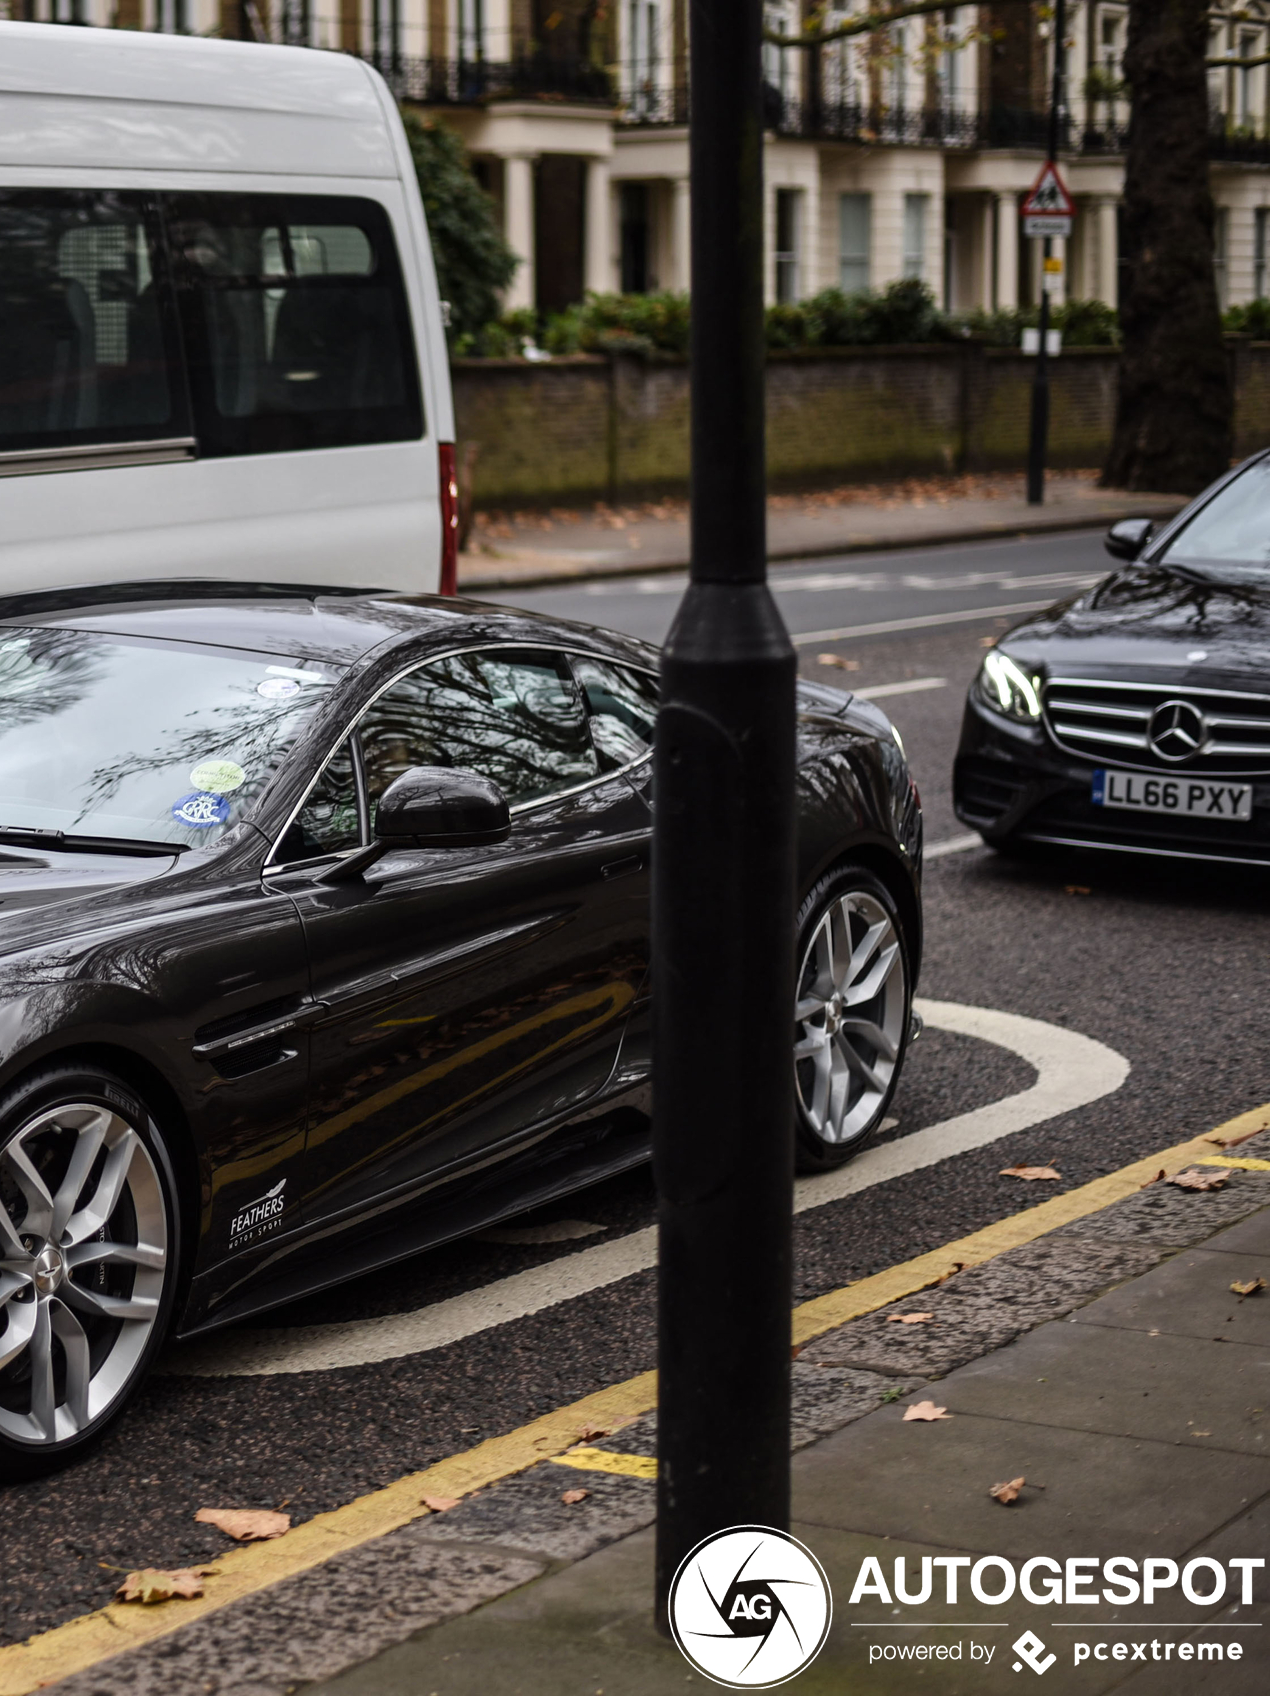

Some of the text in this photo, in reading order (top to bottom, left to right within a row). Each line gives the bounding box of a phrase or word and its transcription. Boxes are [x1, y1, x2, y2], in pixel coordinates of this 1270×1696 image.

[1107, 775, 1246, 816] LL66 PXY
[230, 1194, 285, 1236] FEATHERS
